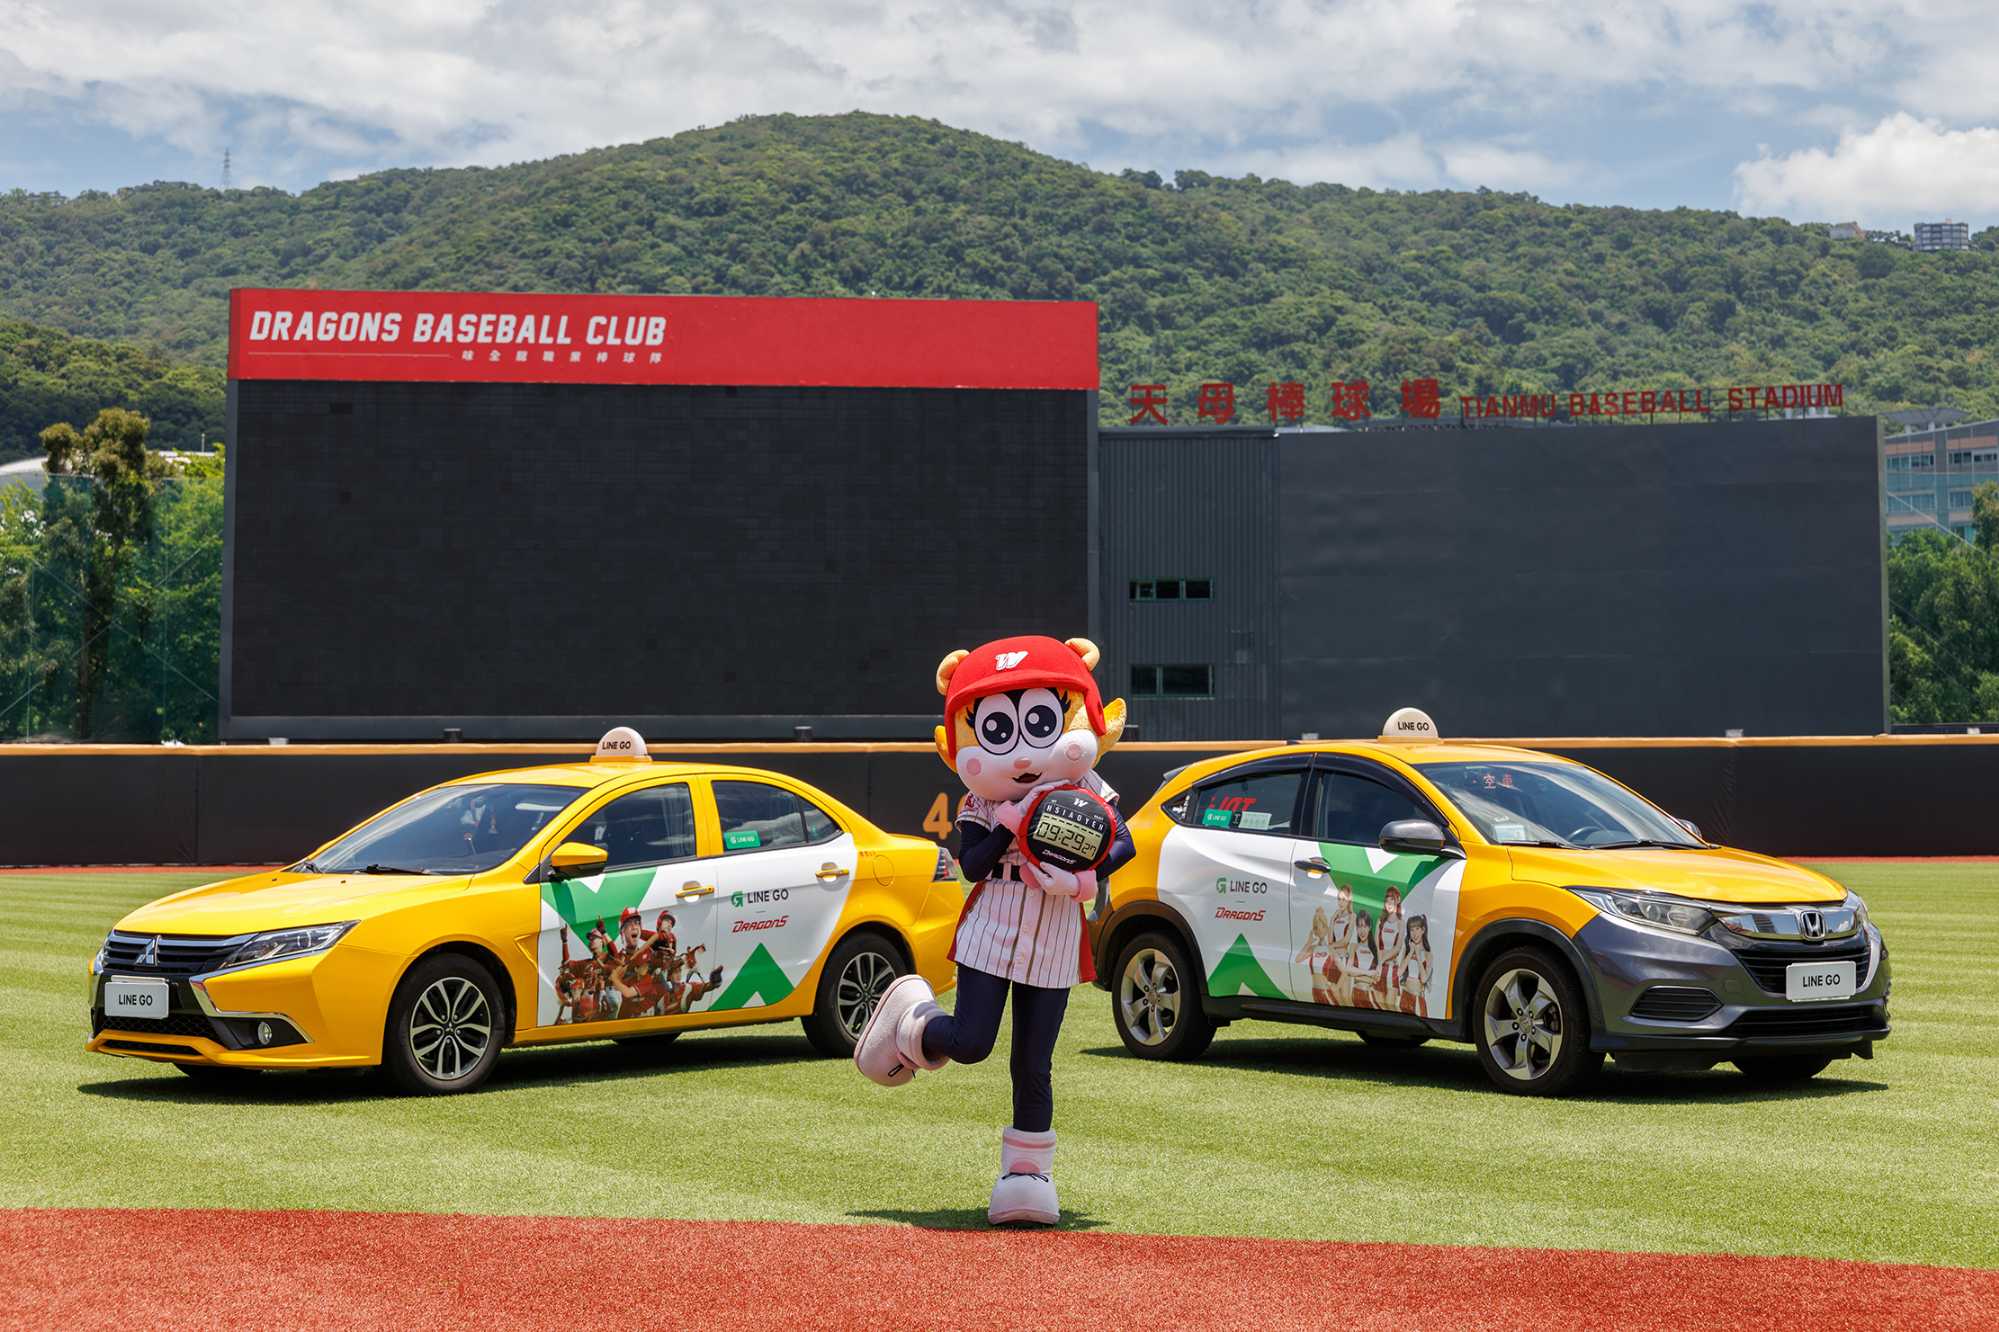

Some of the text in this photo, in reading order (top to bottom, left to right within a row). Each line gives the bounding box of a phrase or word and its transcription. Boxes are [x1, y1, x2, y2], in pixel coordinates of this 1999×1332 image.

[249, 310, 667, 346] DRAGONS BASEBALL CLUB
[1129, 378, 1441, 424] 天母棒球場
[1459, 384, 1843, 418] TIANMU BASEBALL STADIUM
[1397, 721, 1430, 731] LINE GO
[602, 740, 632, 750] LINE GO
[923, 792, 968, 840] 4
[1230, 880, 1250, 893] LINE
[1252, 882, 1268, 894] GO
[747, 890, 770, 904] LINE
[772, 888, 789, 901] GO
[1802, 974, 1841, 987] LINE GO
[118, 994, 153, 1006] LINE GO
